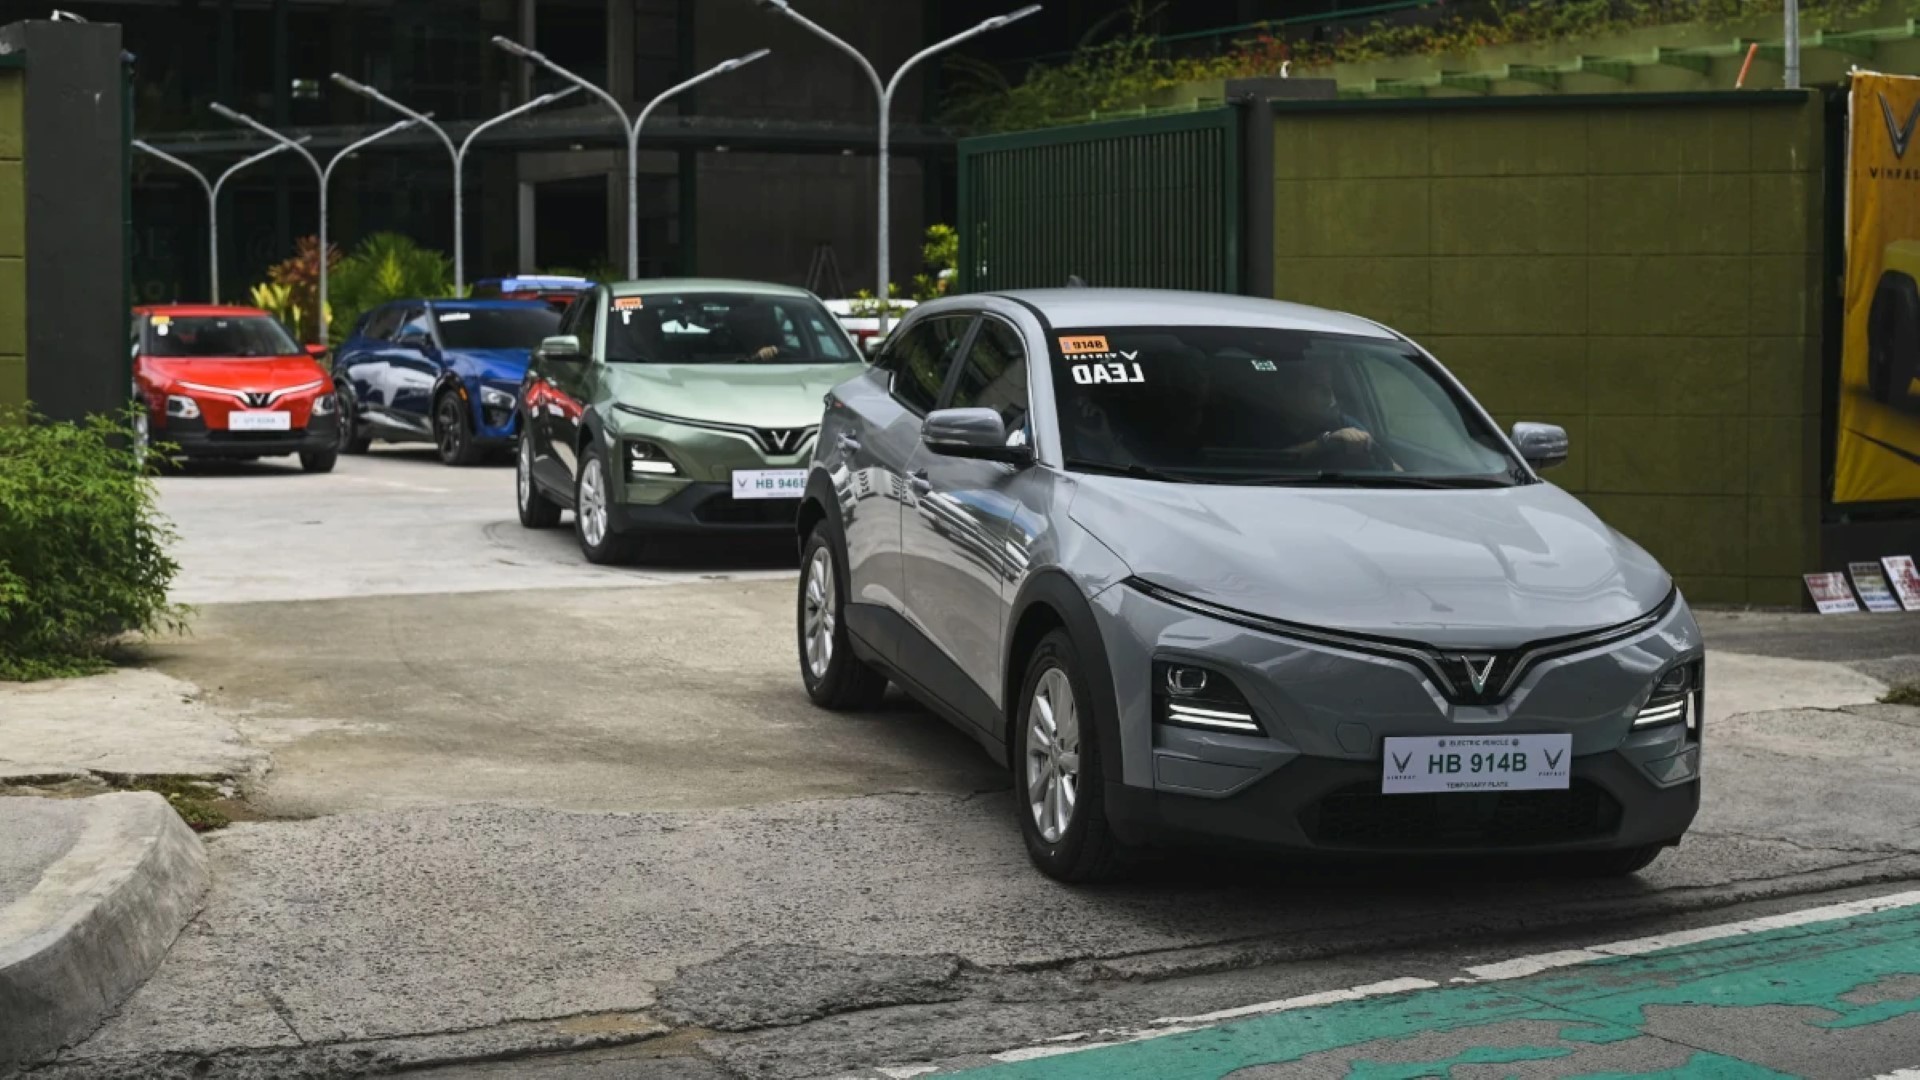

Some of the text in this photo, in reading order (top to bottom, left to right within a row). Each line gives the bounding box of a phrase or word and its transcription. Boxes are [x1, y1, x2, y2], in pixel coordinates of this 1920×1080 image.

[755, 477, 773, 489] HB
[1450, 739, 1480, 747] ELECTRIC
[1428, 752, 1528, 774] HB 914B
[1446, 780, 1509, 789] TEMPORARY PLATE
